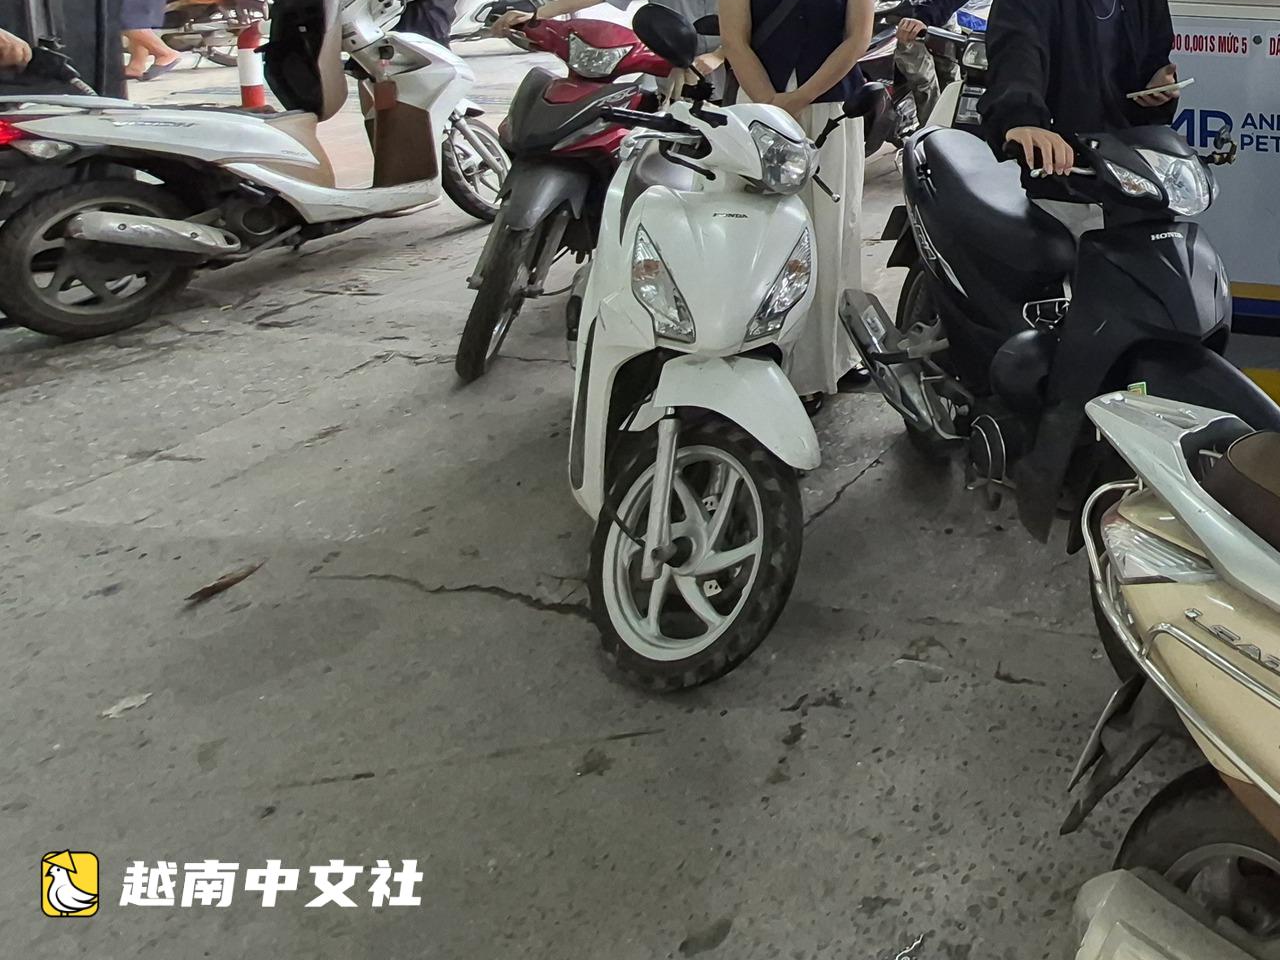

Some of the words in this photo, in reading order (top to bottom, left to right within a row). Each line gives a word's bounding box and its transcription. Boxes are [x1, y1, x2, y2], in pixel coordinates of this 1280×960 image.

[1185, 34, 1215, 53] 0,001S
[1218, 32, 1239, 53] MỨC
[1241, 37, 1247, 54] 5
